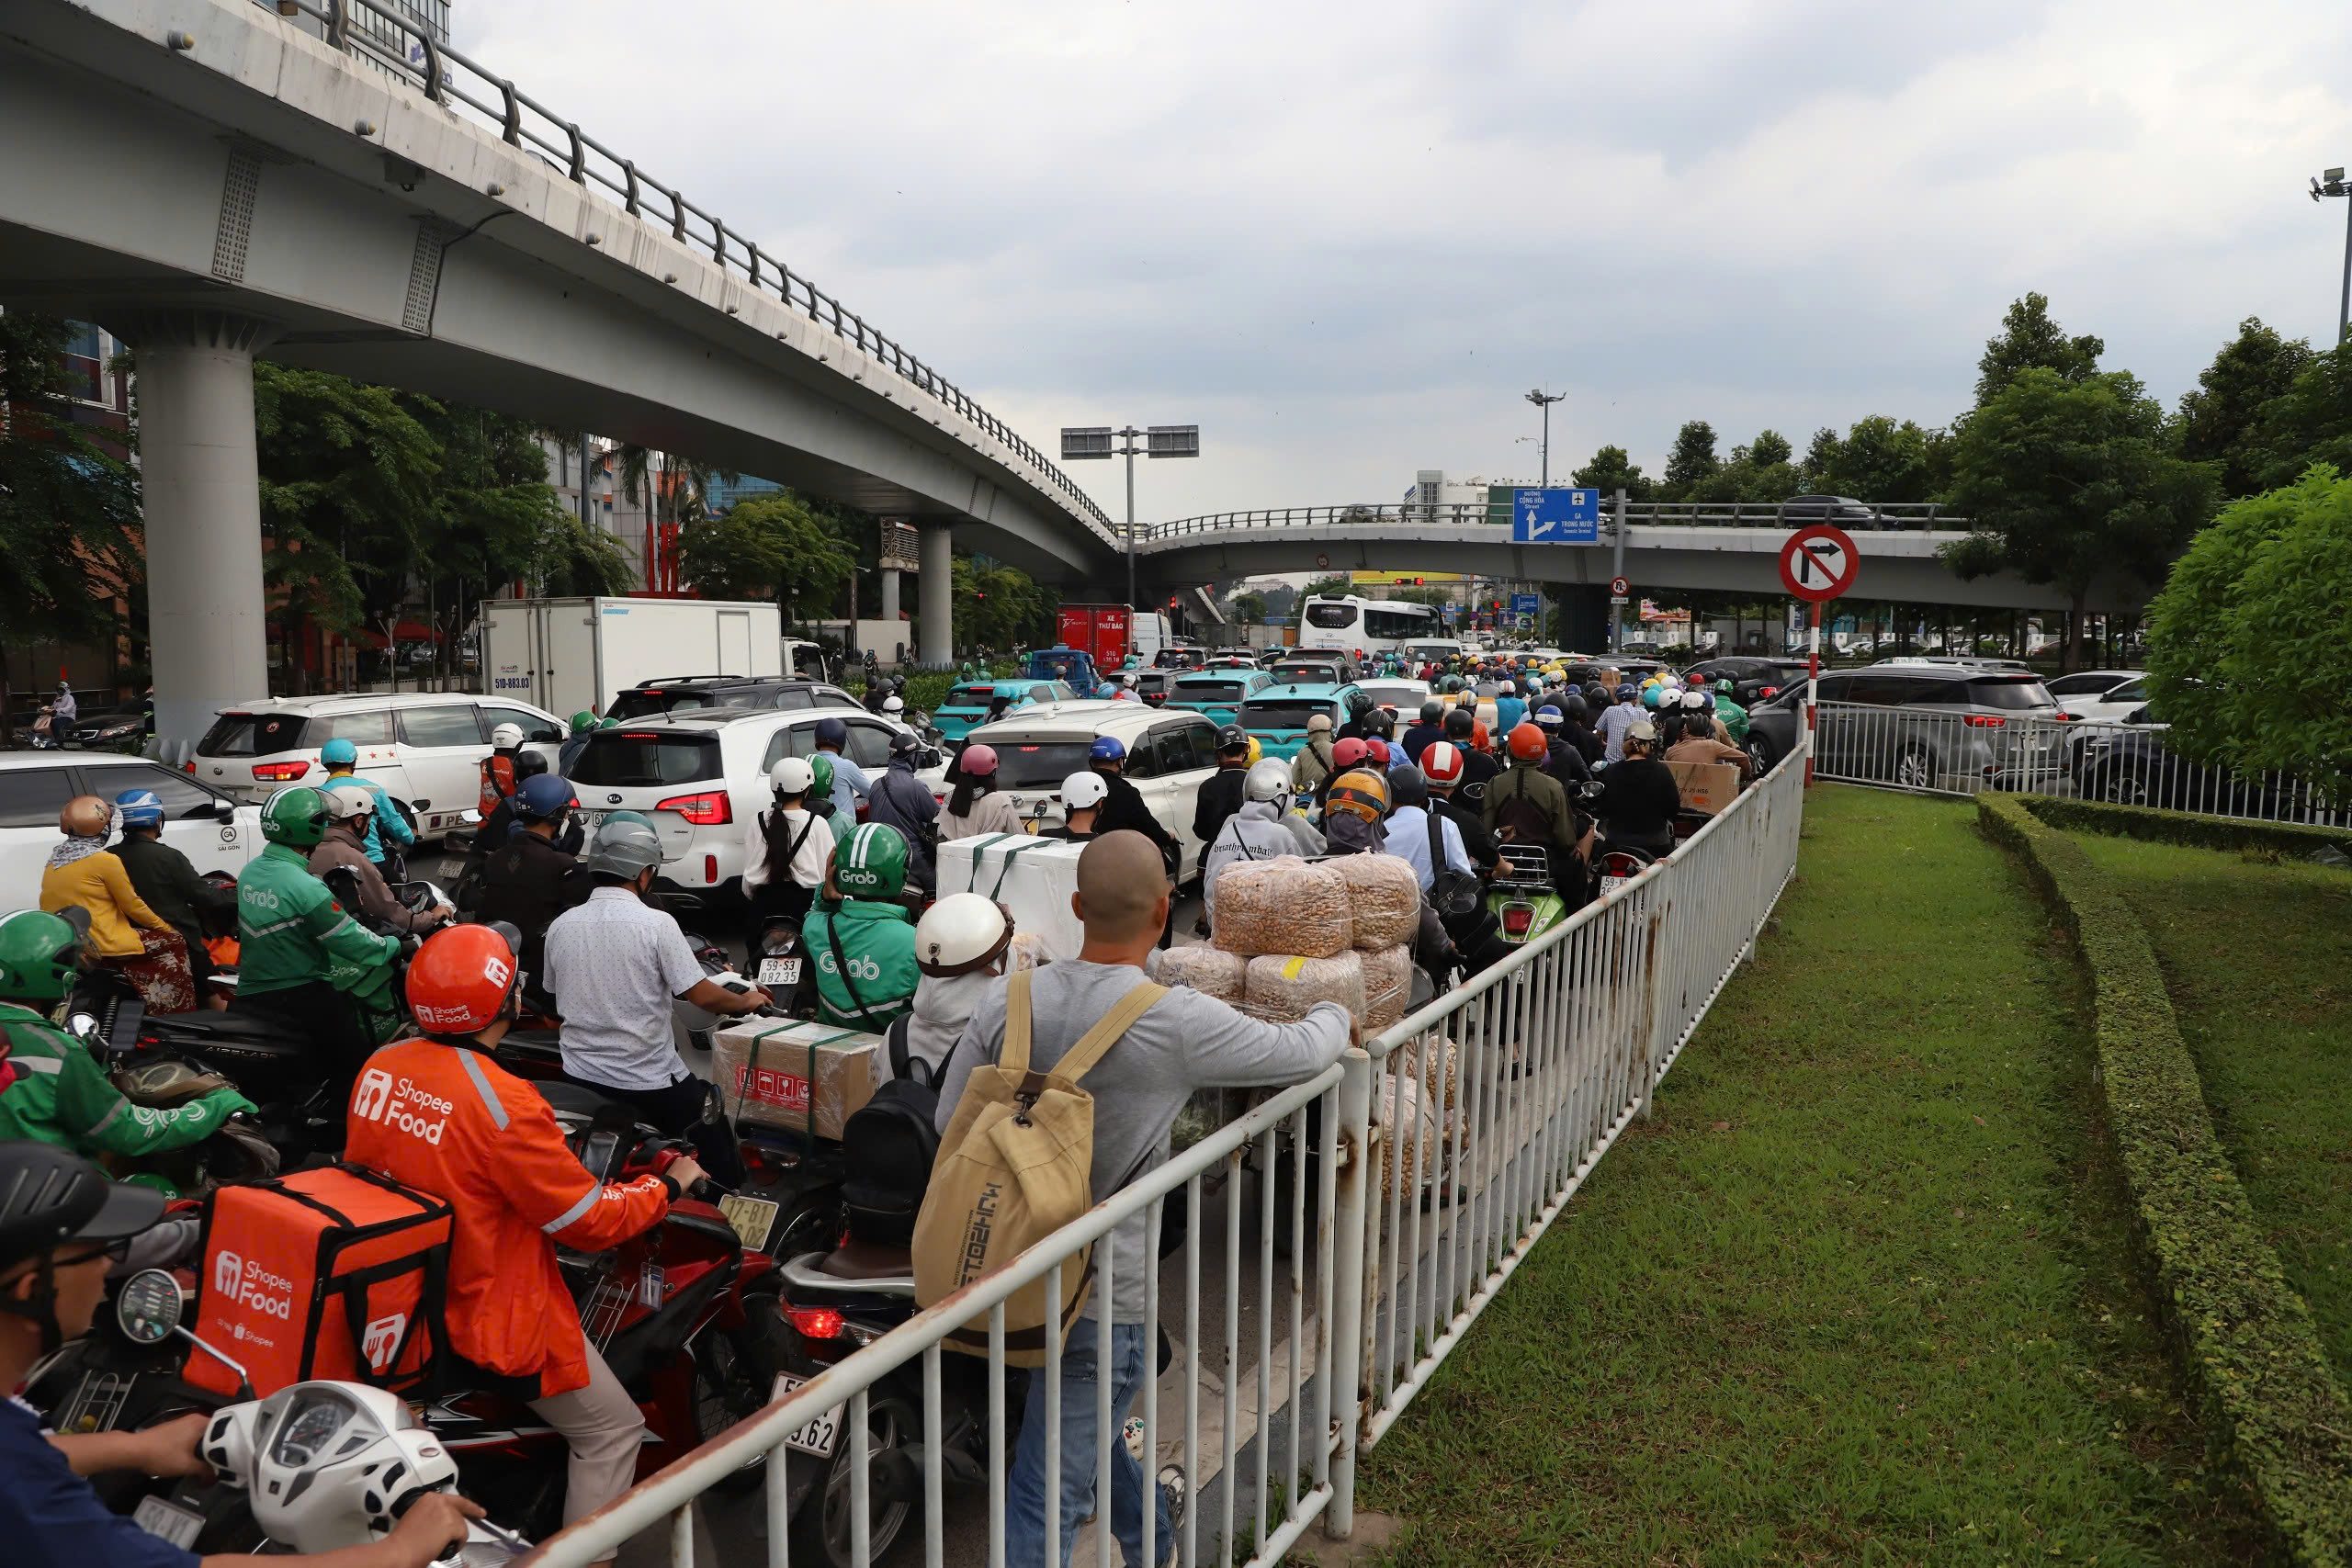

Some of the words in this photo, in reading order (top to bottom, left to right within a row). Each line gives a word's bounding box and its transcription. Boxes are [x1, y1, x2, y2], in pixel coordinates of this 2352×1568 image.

[495, 678, 530, 689] 51D-883.03
[841, 870, 877, 885] Grab
[243, 886, 279, 909] Grab
[766, 960, 795, 971] 59-S3
[760, 972, 797, 983] 082.35
[433, 1005, 468, 1015] Shopee
[435, 1010, 471, 1024] Food
[395, 1078, 454, 1115] Shopee
[384, 1100, 447, 1145] Food
[729, 1200, 768, 1224] 17-B1
[244, 1261, 293, 1293] Shopee
[239, 1281, 291, 1320] Food
[245, 1331, 274, 1348] Shopee
